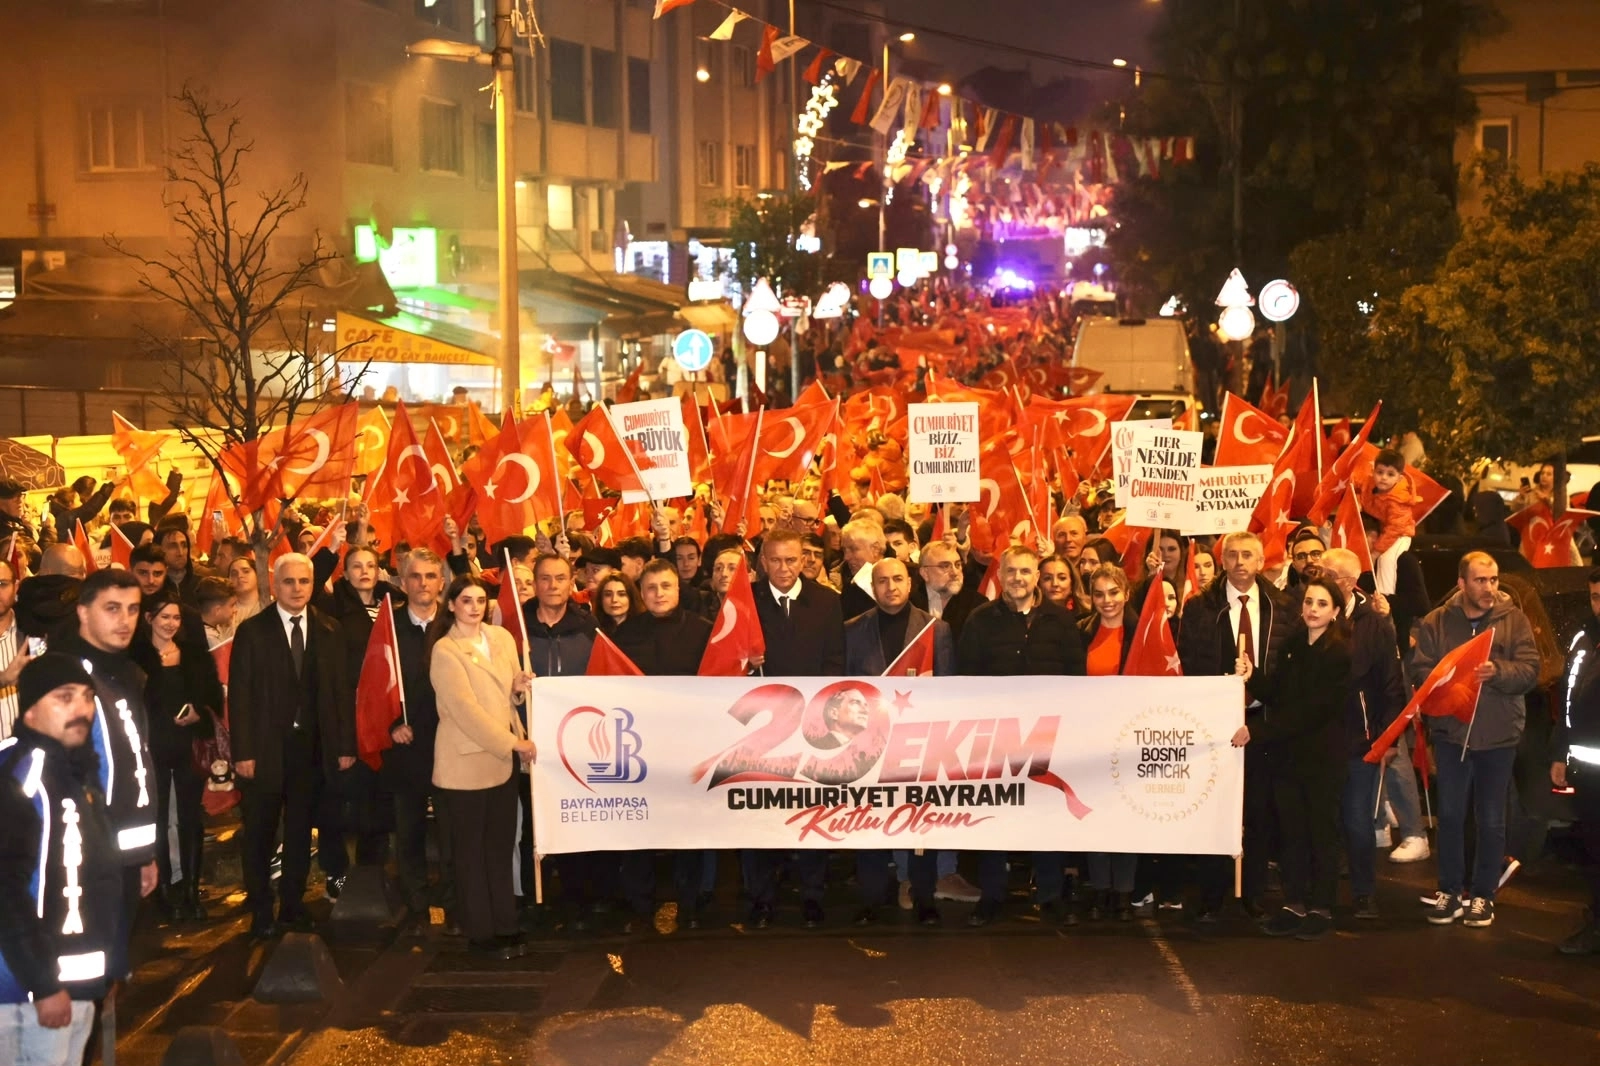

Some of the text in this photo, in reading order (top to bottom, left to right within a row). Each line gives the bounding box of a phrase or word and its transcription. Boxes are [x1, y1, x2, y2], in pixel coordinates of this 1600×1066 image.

[344, 328, 394, 344] CAFE
[343, 345, 398, 360] NECO
[623, 408, 671, 432] CUMHURİYET
[913, 412, 975, 434] CUMHURİYET
[637, 427, 684, 453] BÜYÜK
[928, 431, 962, 446] BİZİZ,
[1153, 435, 1181, 450] HER
[934, 445, 955, 459] BİZ
[1135, 447, 1197, 469] NESİLDE
[913, 458, 976, 475] CUMHURİYETİZ!
[1141, 466, 1189, 482] YENİDEN
[1130, 478, 1195, 502] CUMHURİYET!
[1202, 488, 1249, 500] ORTAK
[706, 680, 1061, 792] 29 EKİM
[1133, 727, 1195, 746] TÜRKİYE
[1141, 747, 1187, 762] BOSNA
[1137, 763, 1191, 779] SANCAK
[561, 797, 648, 810] BAYRAMPAŞA
[727, 783, 1025, 810] CUMHURİYET BAYRAMI
[561, 808, 649, 823] BELEDİYESİ
[785, 801, 995, 842] Kutlu Olsun
